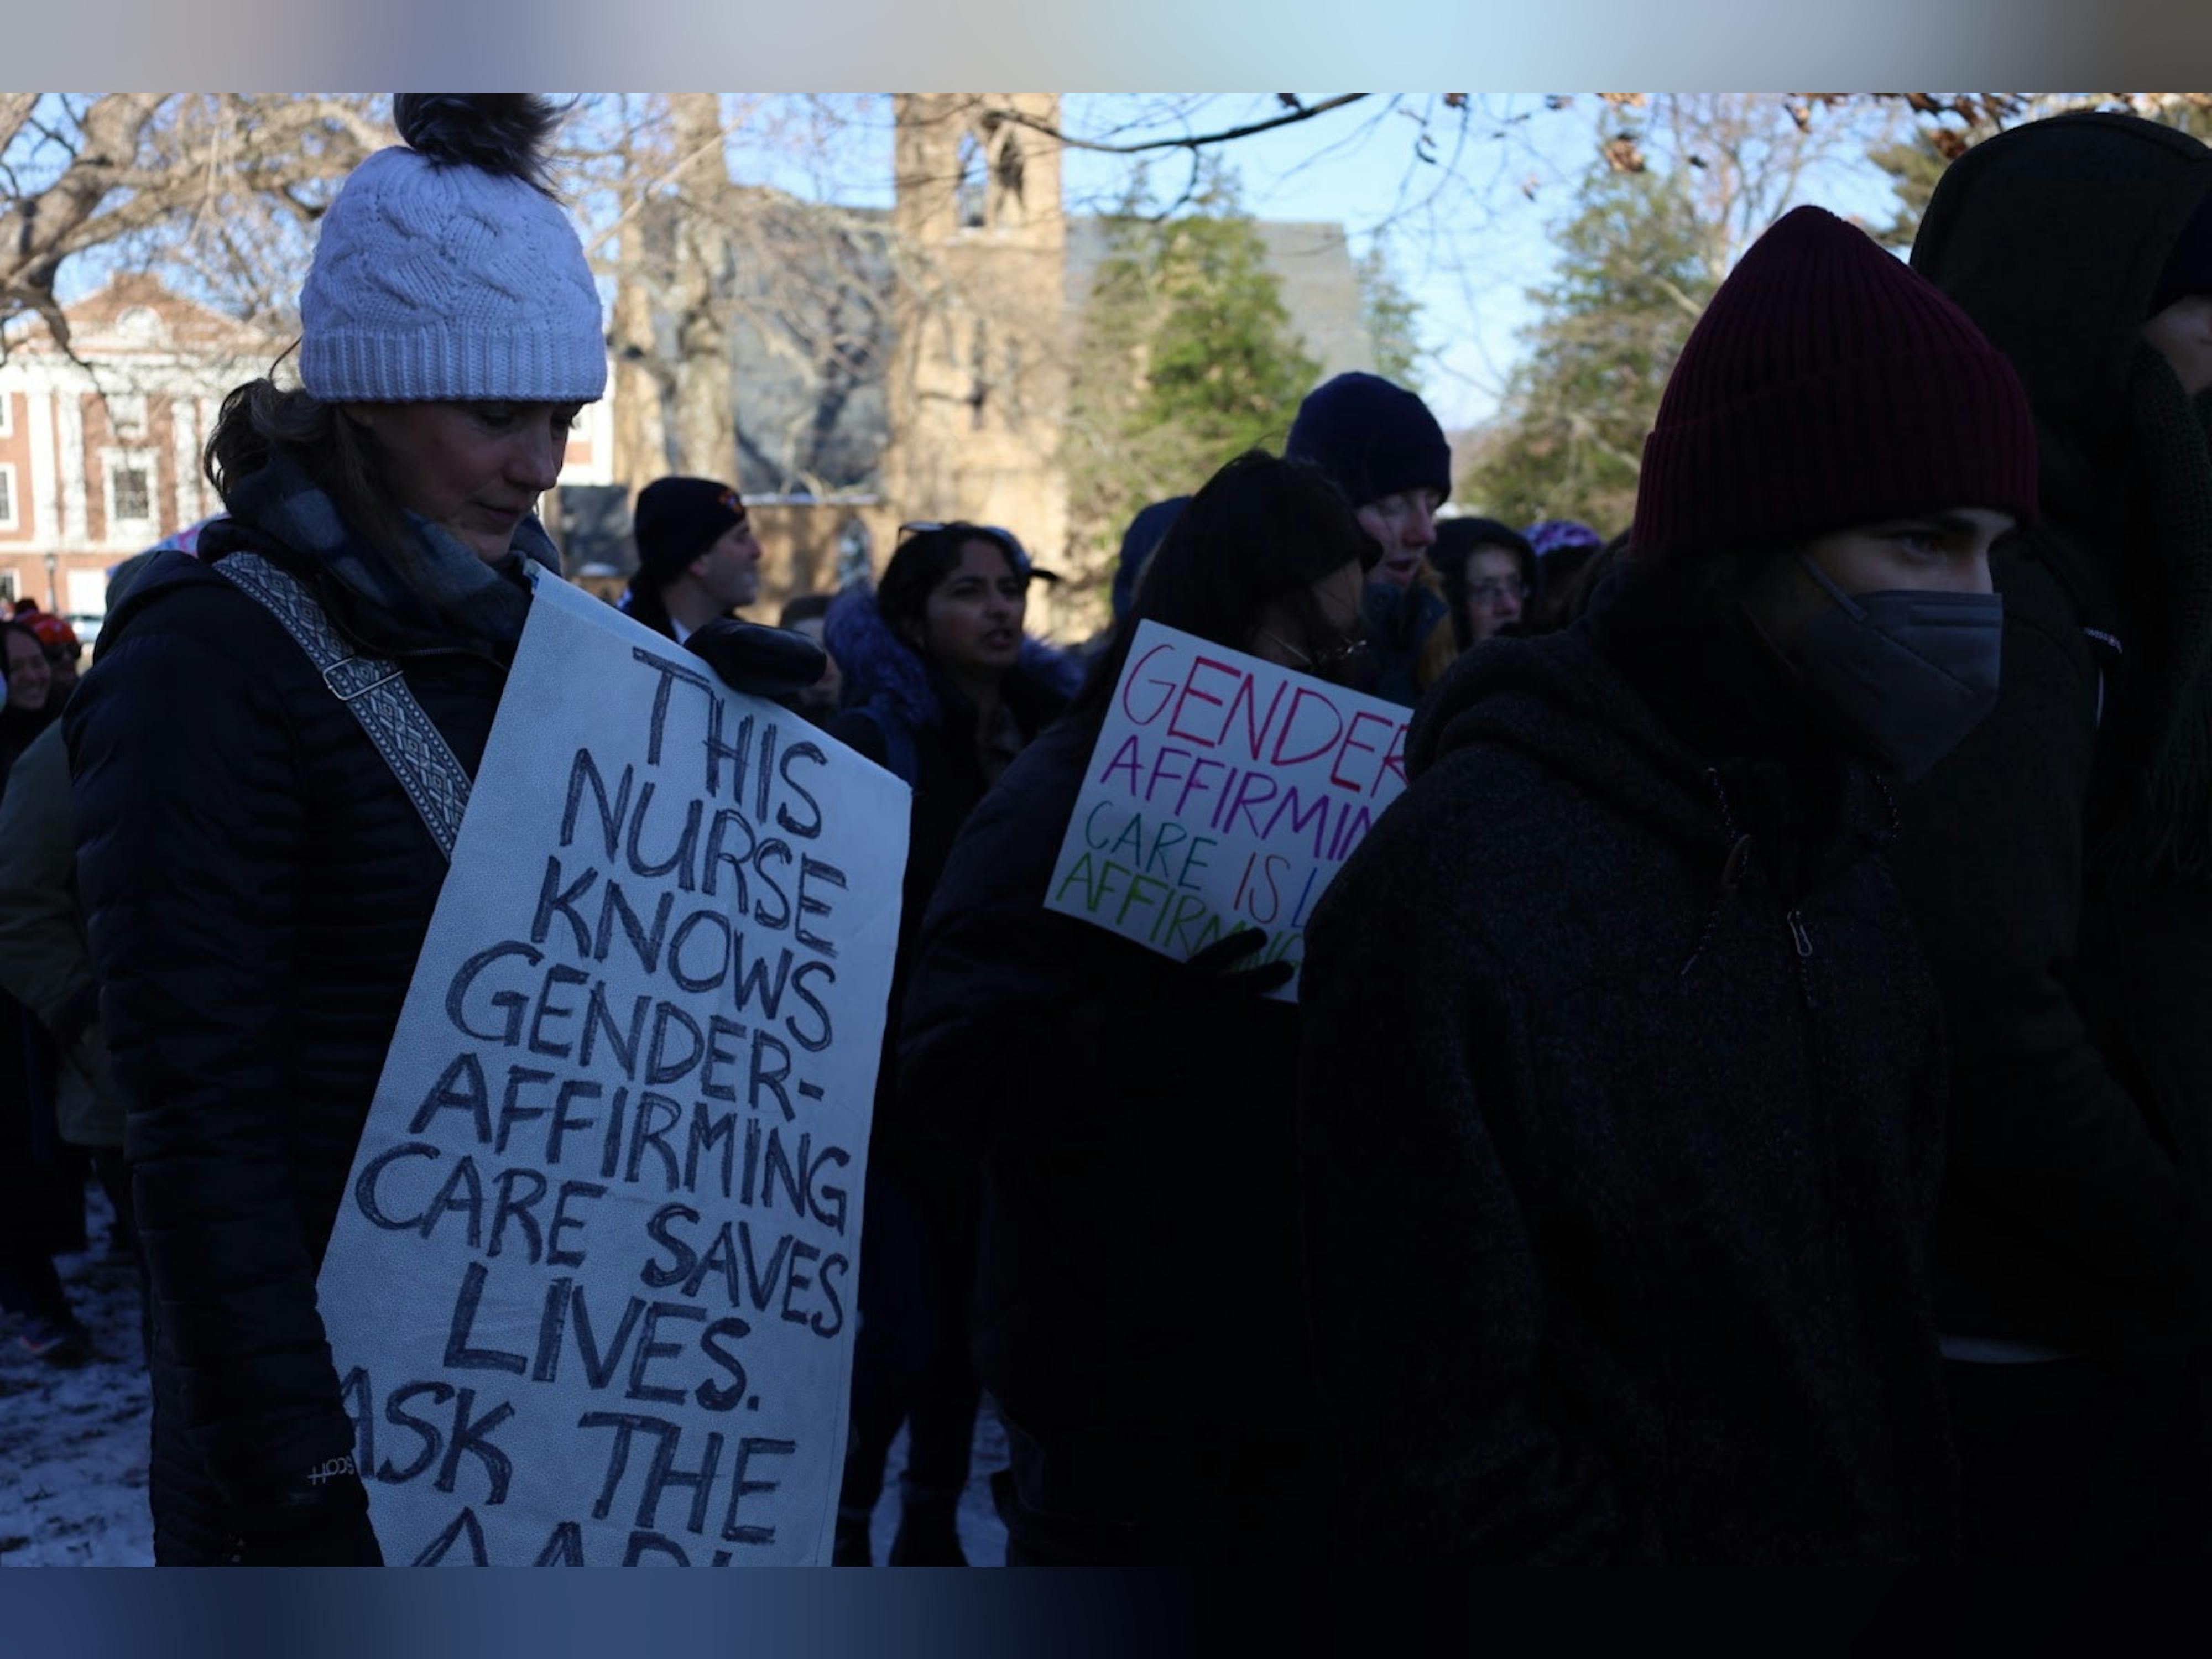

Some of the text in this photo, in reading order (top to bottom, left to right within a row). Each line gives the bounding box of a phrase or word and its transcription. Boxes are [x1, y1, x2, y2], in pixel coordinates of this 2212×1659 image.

[633, 647, 828, 839] THIS
[1123, 644, 1413, 799] GENDER
[560, 748, 849, 958] NURSE
[1086, 801, 1217, 891] CARE
[1234, 851, 1291, 924] IS
[445, 940, 825, 1122] GENDER-
[530, 855, 836, 1052] KNOWS
[409, 1053, 851, 1236] AFFIRMING
[356, 1141, 849, 1339] CARE SAVES
[444, 1261, 759, 1411] LIVES.
[341, 1366, 515, 1505] ASK
[578, 1412, 796, 1544] THE
